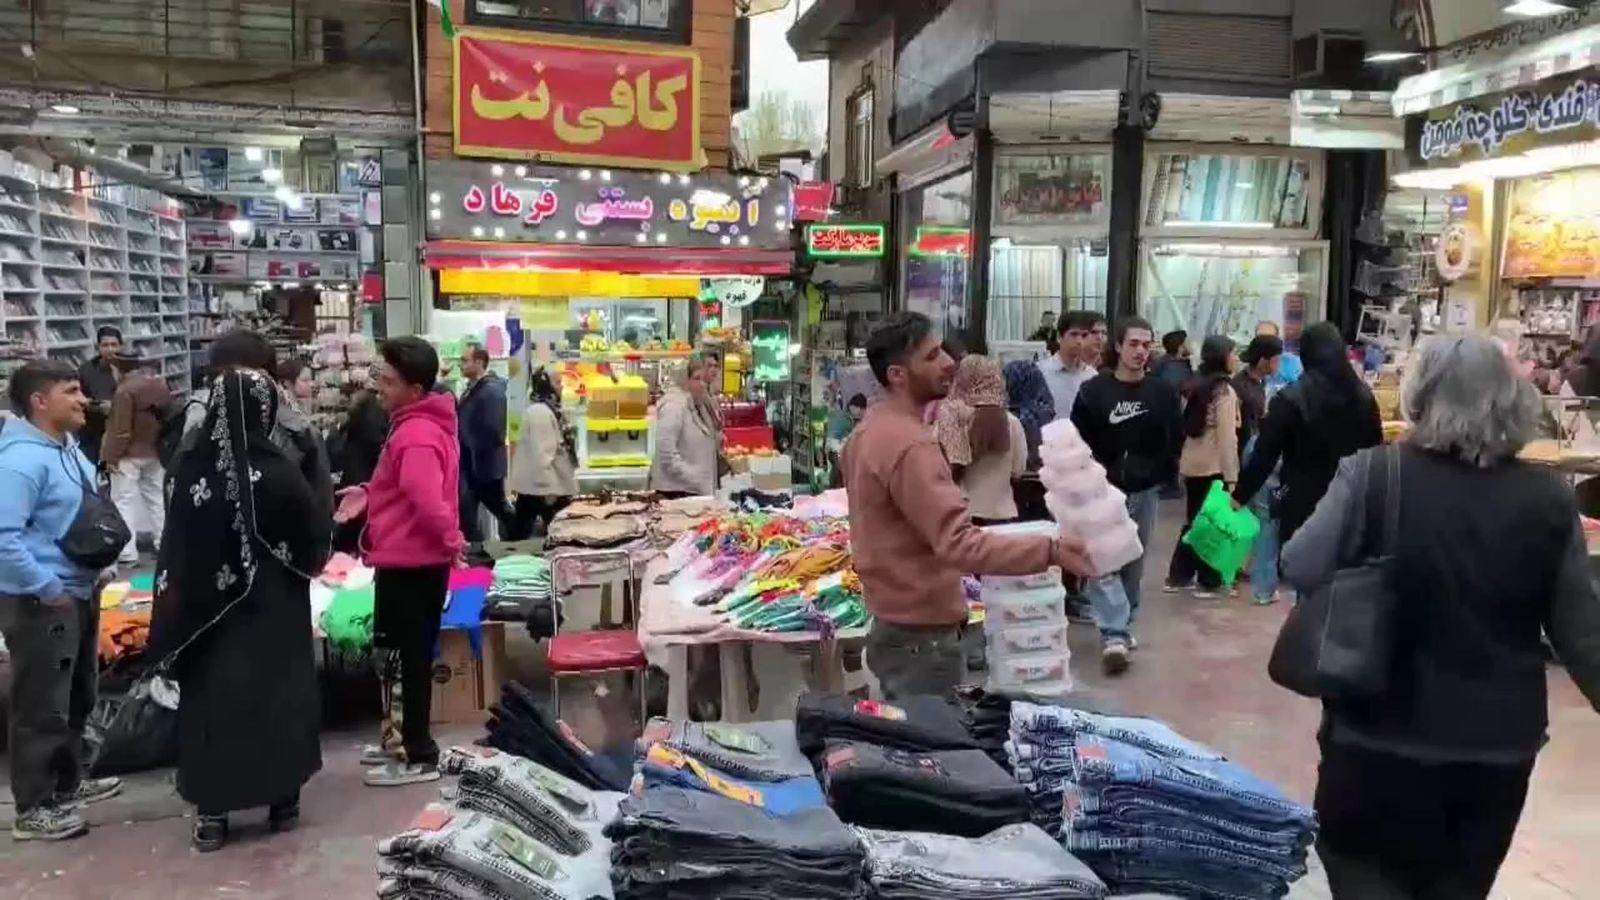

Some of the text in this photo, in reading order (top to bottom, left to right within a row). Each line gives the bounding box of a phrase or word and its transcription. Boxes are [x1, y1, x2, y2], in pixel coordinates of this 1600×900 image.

[470, 59, 550, 121] نت
[553, 63, 688, 145] کافی
[1467, 95, 1530, 157] کلوچه
[463, 180, 557, 225] فرهاد
[575, 186, 654, 232] بستنی
[1114, 401, 1142, 414] NIKE
